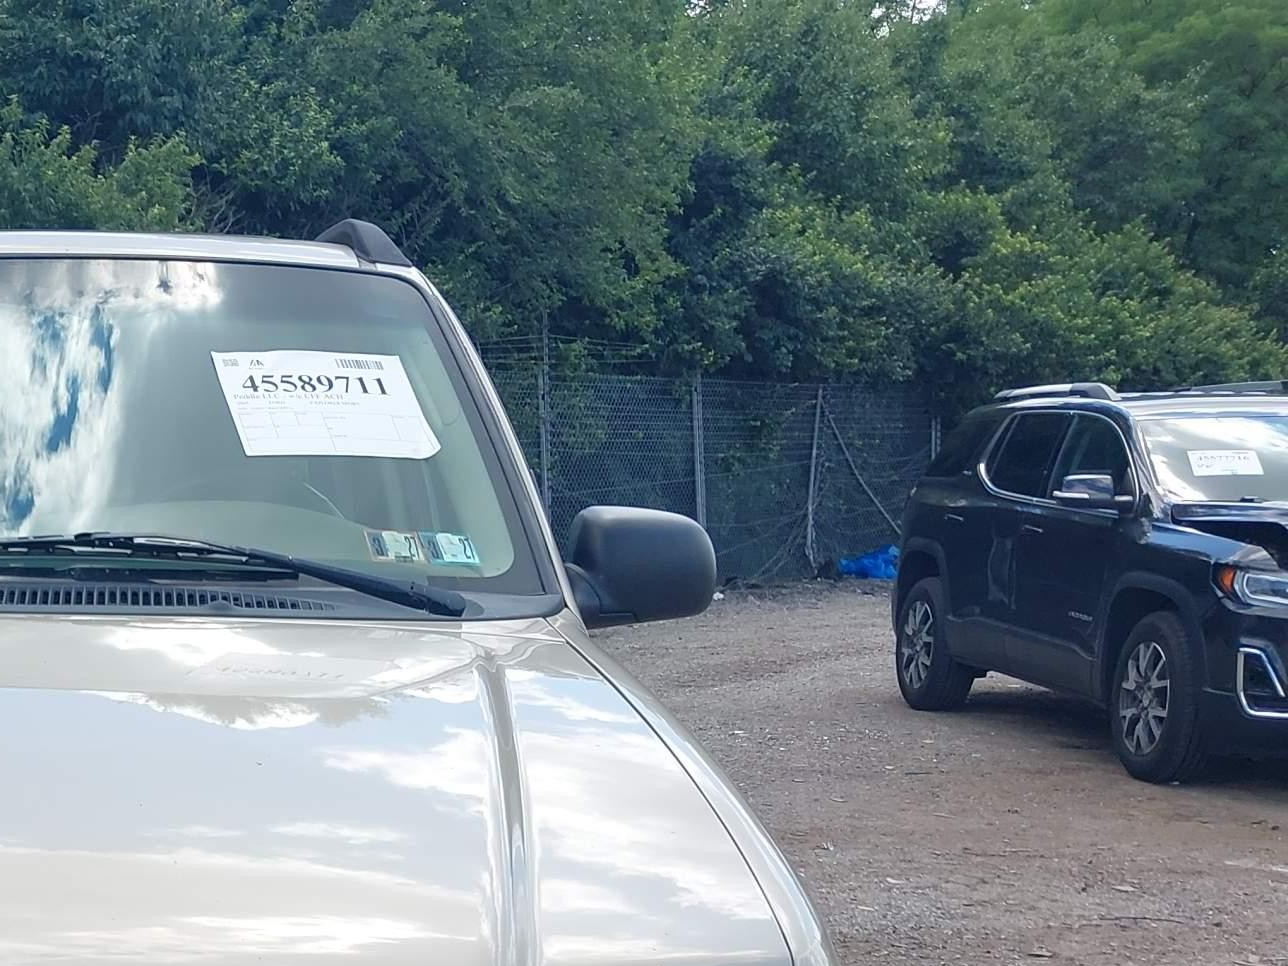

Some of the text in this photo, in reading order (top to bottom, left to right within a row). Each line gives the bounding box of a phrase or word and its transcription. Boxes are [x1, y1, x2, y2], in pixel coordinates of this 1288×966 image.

[242, 374, 390, 396] 45589711
[372, 535, 420, 560] 3 27
